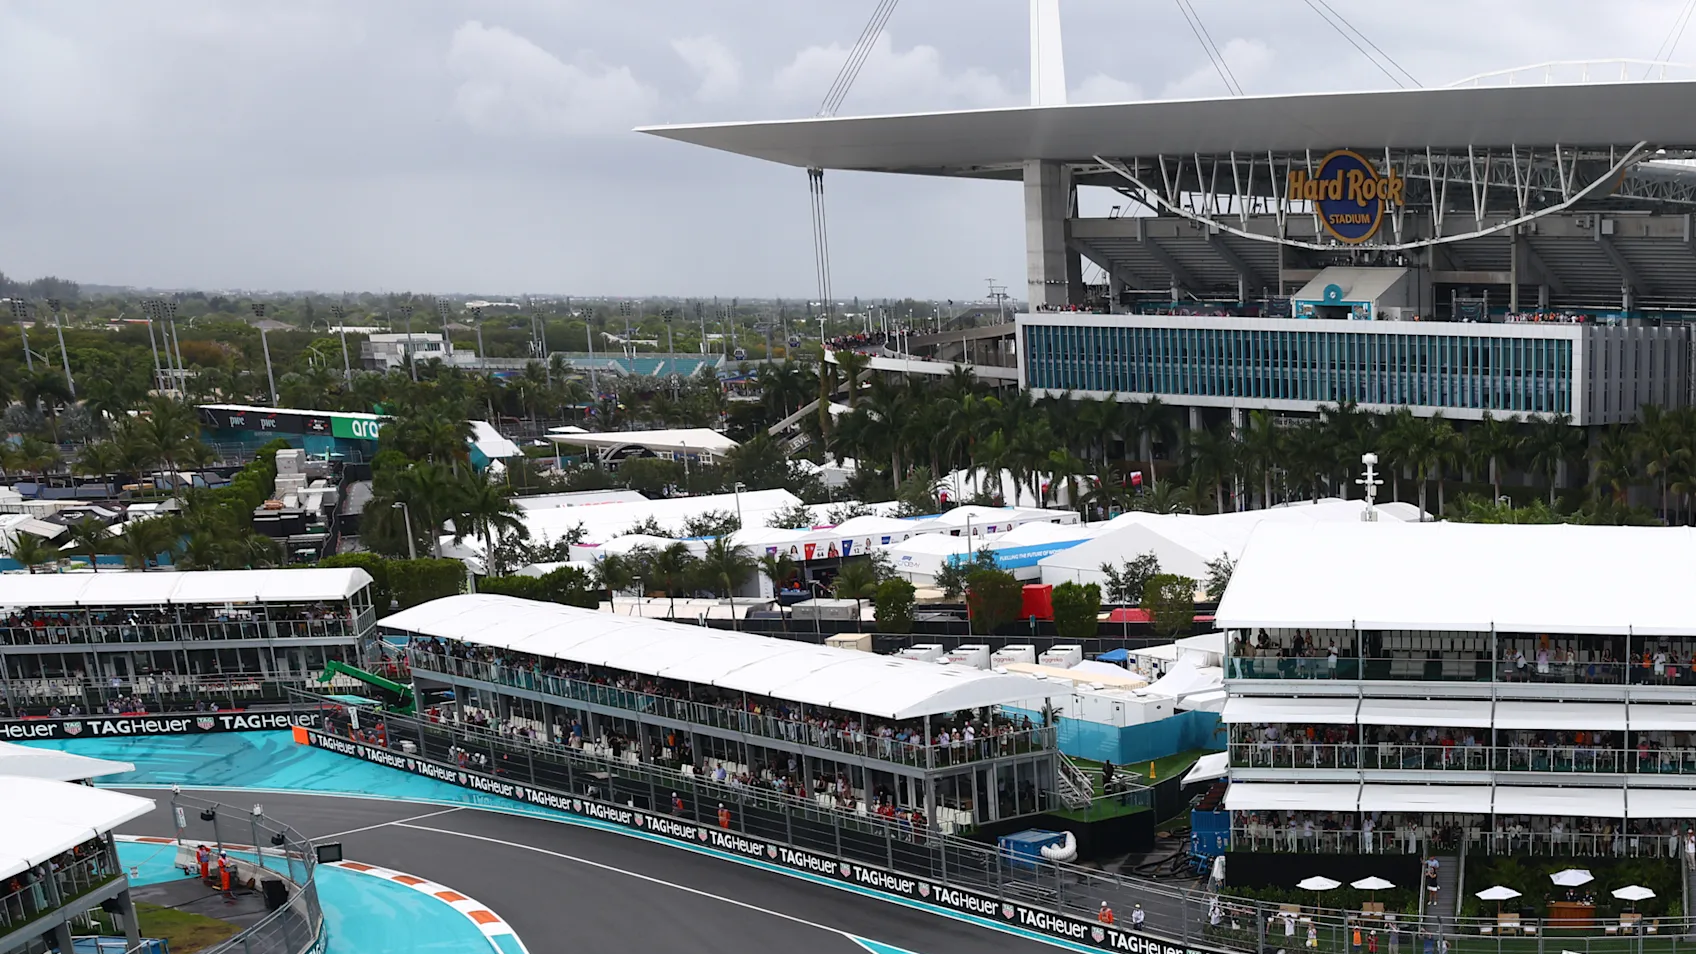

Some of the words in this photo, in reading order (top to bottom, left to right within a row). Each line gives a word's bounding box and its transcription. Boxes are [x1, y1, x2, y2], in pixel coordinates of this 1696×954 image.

[1289, 170, 1344, 200] Hard
[1347, 168, 1403, 206] Rock
[1329, 213, 1371, 226] STADIUM
[229, 416, 245, 428] pwc
[260, 418, 276, 429] pwc
[87, 718, 191, 735] TAGHeuer
[220, 712, 319, 729] TAGHeuer
[317, 734, 355, 756] TAGHeuer
[366, 748, 406, 770] TAGHeuer
[416, 761, 457, 783] TAGHeuer
[469, 774, 514, 797] TAGHeuer
[525, 789, 572, 811] TAGHeuer
[583, 801, 633, 825] TAGHeuer
[645, 815, 697, 840] TAGHeuer
[710, 831, 765, 857] TAGHeuer
[780, 847, 838, 875] TAGHeuer
[854, 865, 916, 895] TAGHeuer
[932, 885, 999, 916] TAGHeuer
[1017, 907, 1088, 940] TAGHeuer
